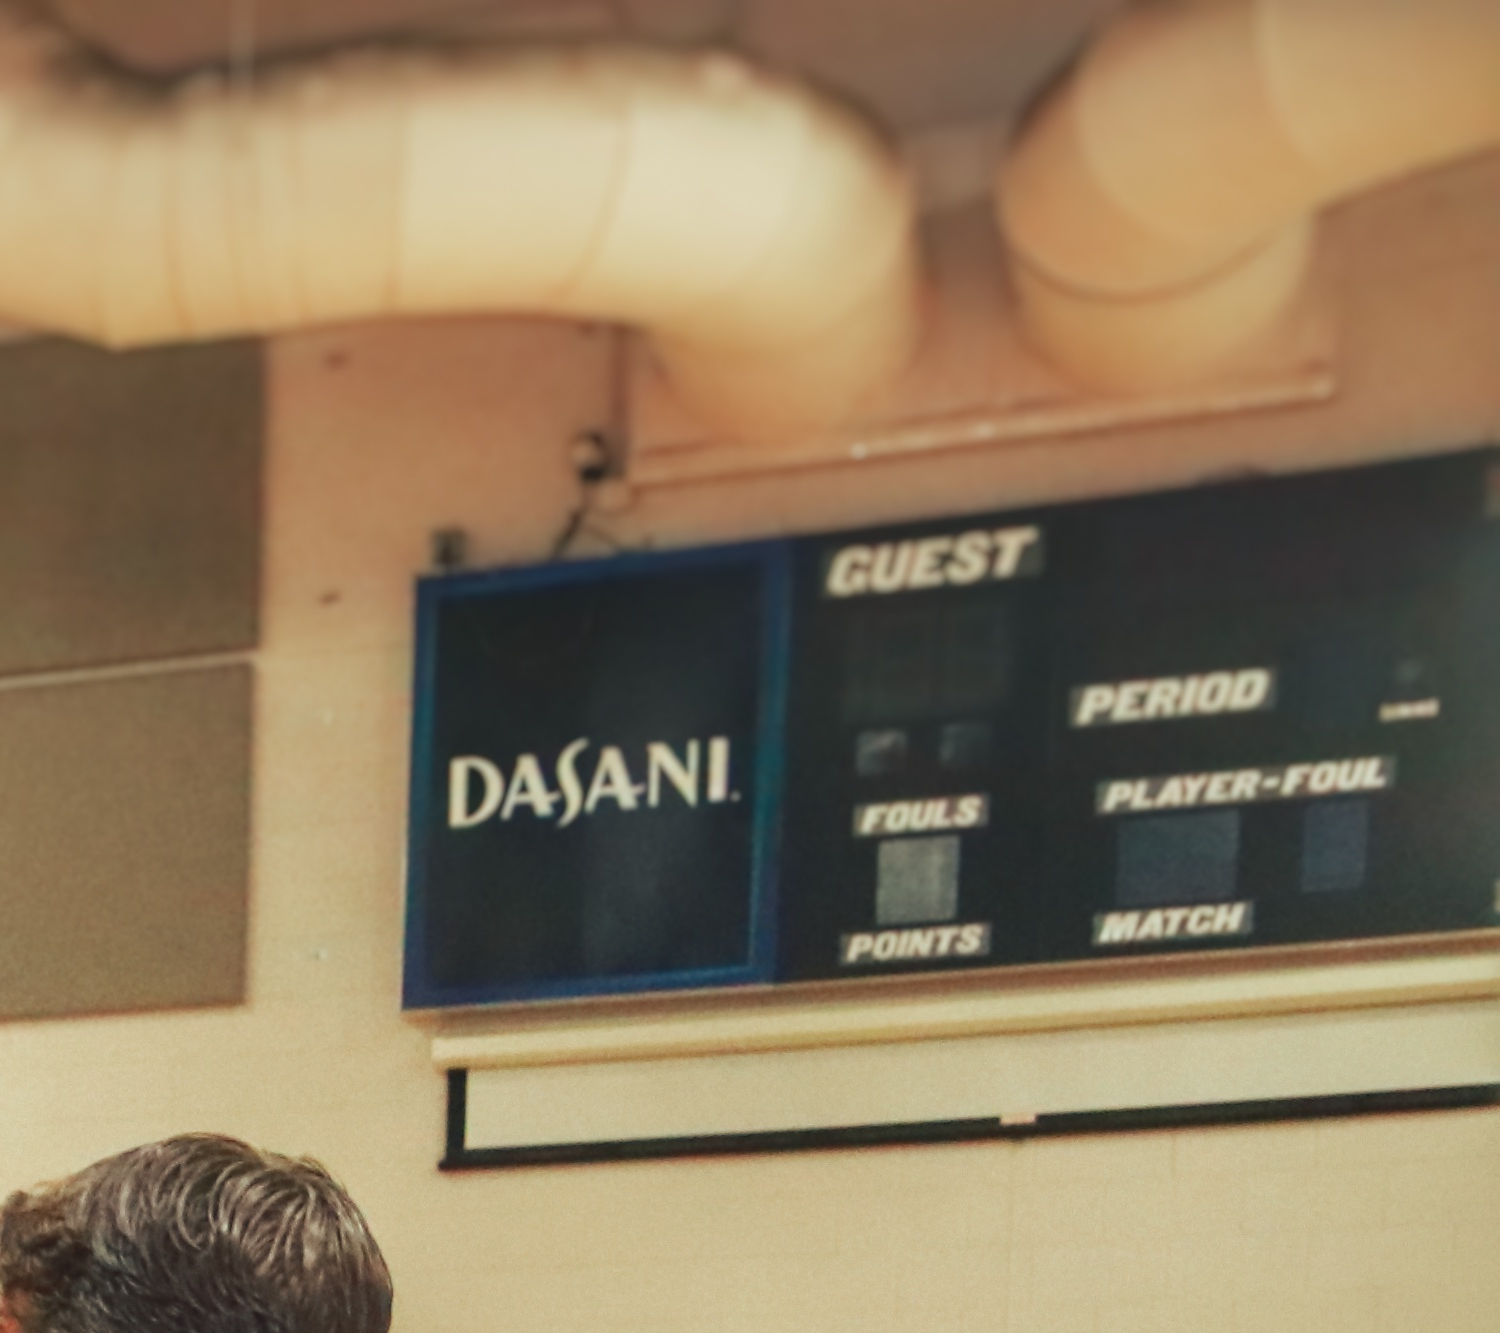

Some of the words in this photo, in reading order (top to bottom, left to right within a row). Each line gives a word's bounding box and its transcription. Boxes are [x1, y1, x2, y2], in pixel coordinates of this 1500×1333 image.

[826, 525, 1040, 597] GUEST
[1075, 668, 1271, 727] PERIOD
[448, 736, 731, 828] DASANI
[1103, 756, 1387, 813] PLAYER-FOUL
[860, 796, 982, 834] FOULS
[846, 924, 984, 962] POINTS
[1098, 902, 1246, 944] MATCH
